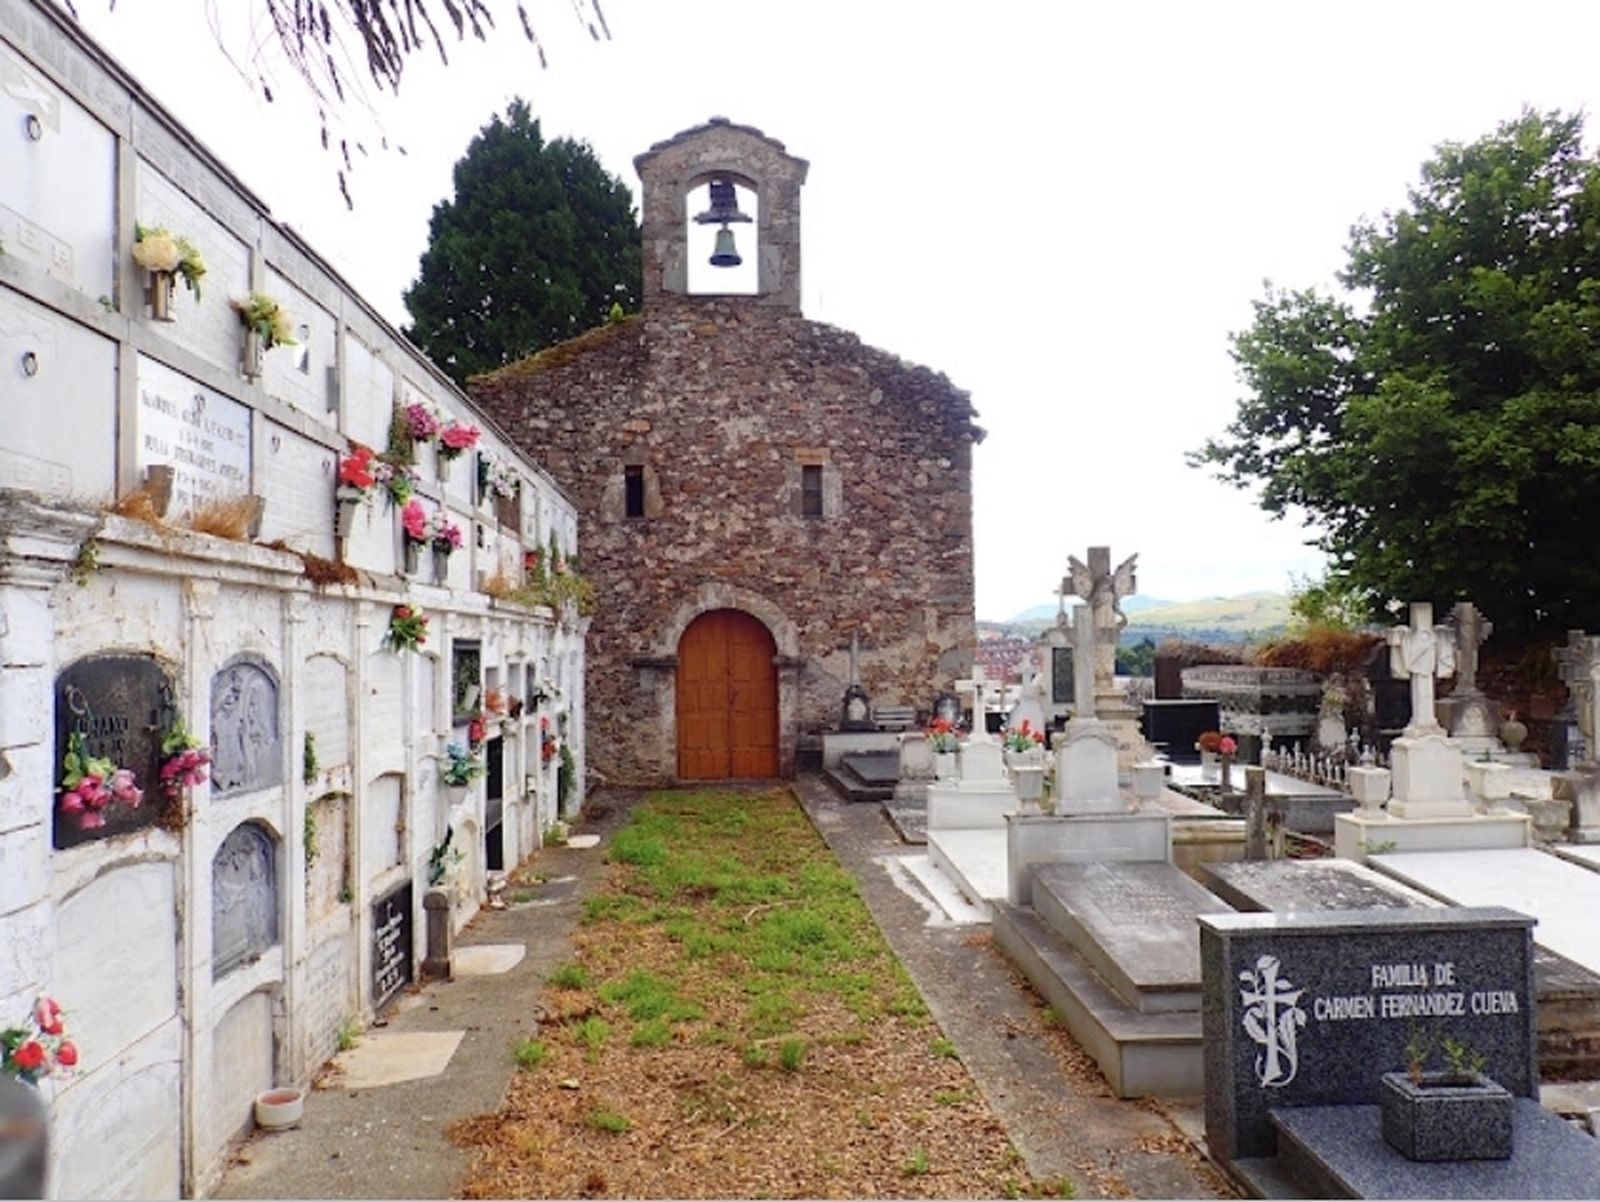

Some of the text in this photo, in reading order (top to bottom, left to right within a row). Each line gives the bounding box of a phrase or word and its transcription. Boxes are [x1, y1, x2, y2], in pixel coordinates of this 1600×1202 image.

[1372, 962, 1456, 988] FAMILIA DE
[1313, 991, 1519, 1020] CARMEN FERNANDEZ CUEVA
